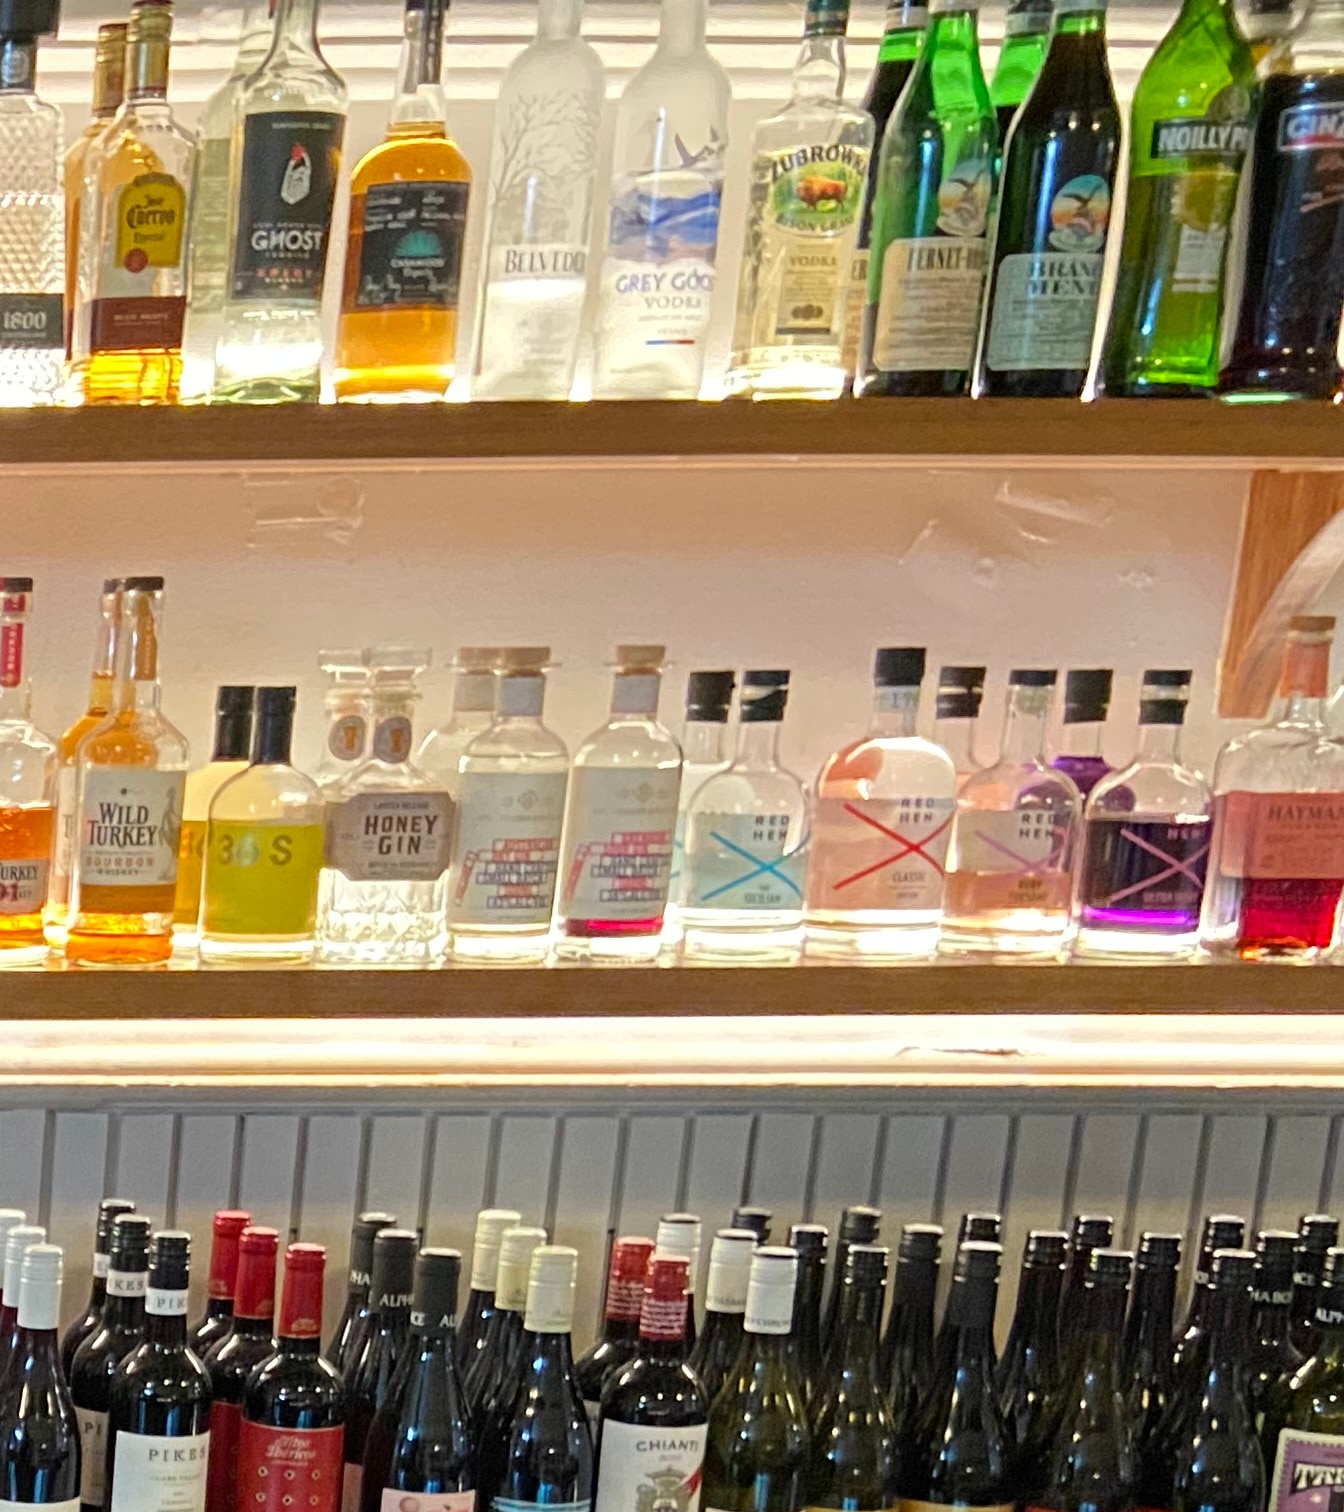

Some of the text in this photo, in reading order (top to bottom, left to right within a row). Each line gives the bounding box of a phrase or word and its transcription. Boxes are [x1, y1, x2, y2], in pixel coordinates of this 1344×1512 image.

[251, 230, 323, 251] GHOST
[616, 272, 667, 294] GREY
[3, 311, 48, 330] 1800
[900, 797, 935, 808] RED
[98, 801, 150, 826] WILD
[755, 815, 790, 827] RED
[899, 812, 933, 823] HEN
[1021, 812, 1055, 824] RED
[364, 814, 439, 836] HONEY
[87, 820, 158, 849] TURKEY
[753, 830, 788, 841] HEN
[1019, 828, 1054, 839] HEN
[378, 835, 422, 856] GIN
[86, 857, 156, 867] BOURBON
[636, 1439, 699, 1453] CHIANTI
[148, 1447, 205, 1463] PIKES
